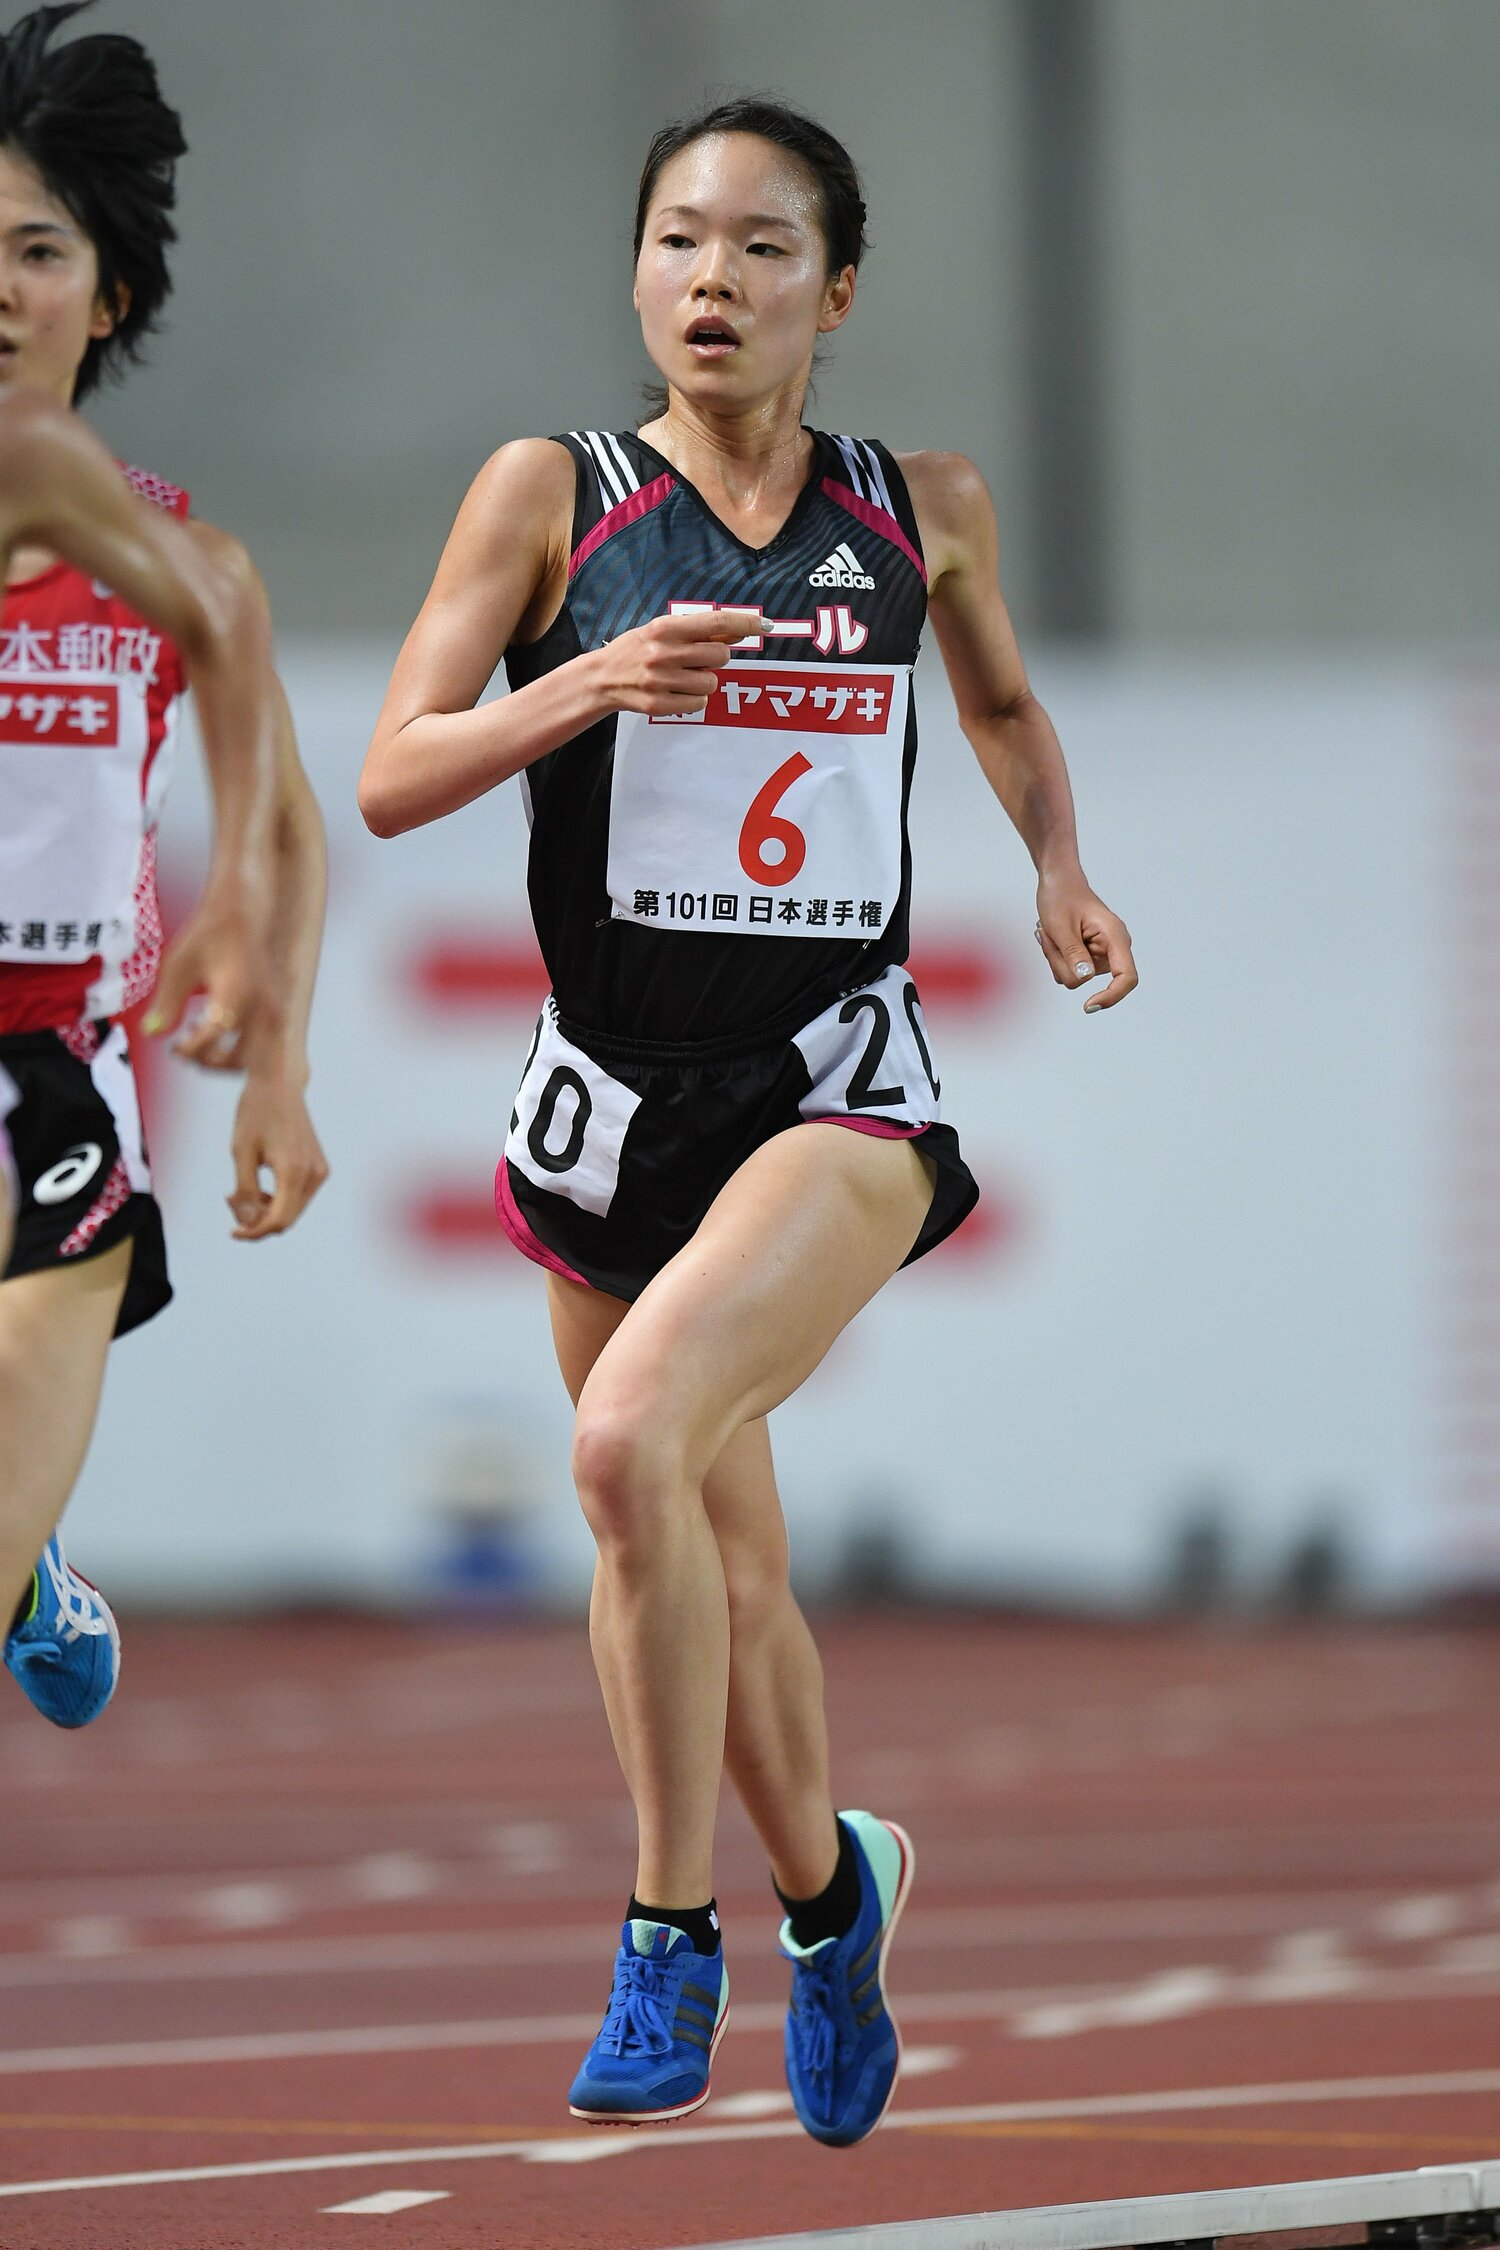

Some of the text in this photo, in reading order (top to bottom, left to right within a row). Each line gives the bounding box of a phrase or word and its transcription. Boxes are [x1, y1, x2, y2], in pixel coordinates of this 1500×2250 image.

[809, 568, 875, 590] adidas
[668, 601, 869, 655] コール
[721, 681, 885, 722] ヤマザキ
[738, 751, 813, 887] 6
[633, 889, 882, 928] 第101回 日本選手権
